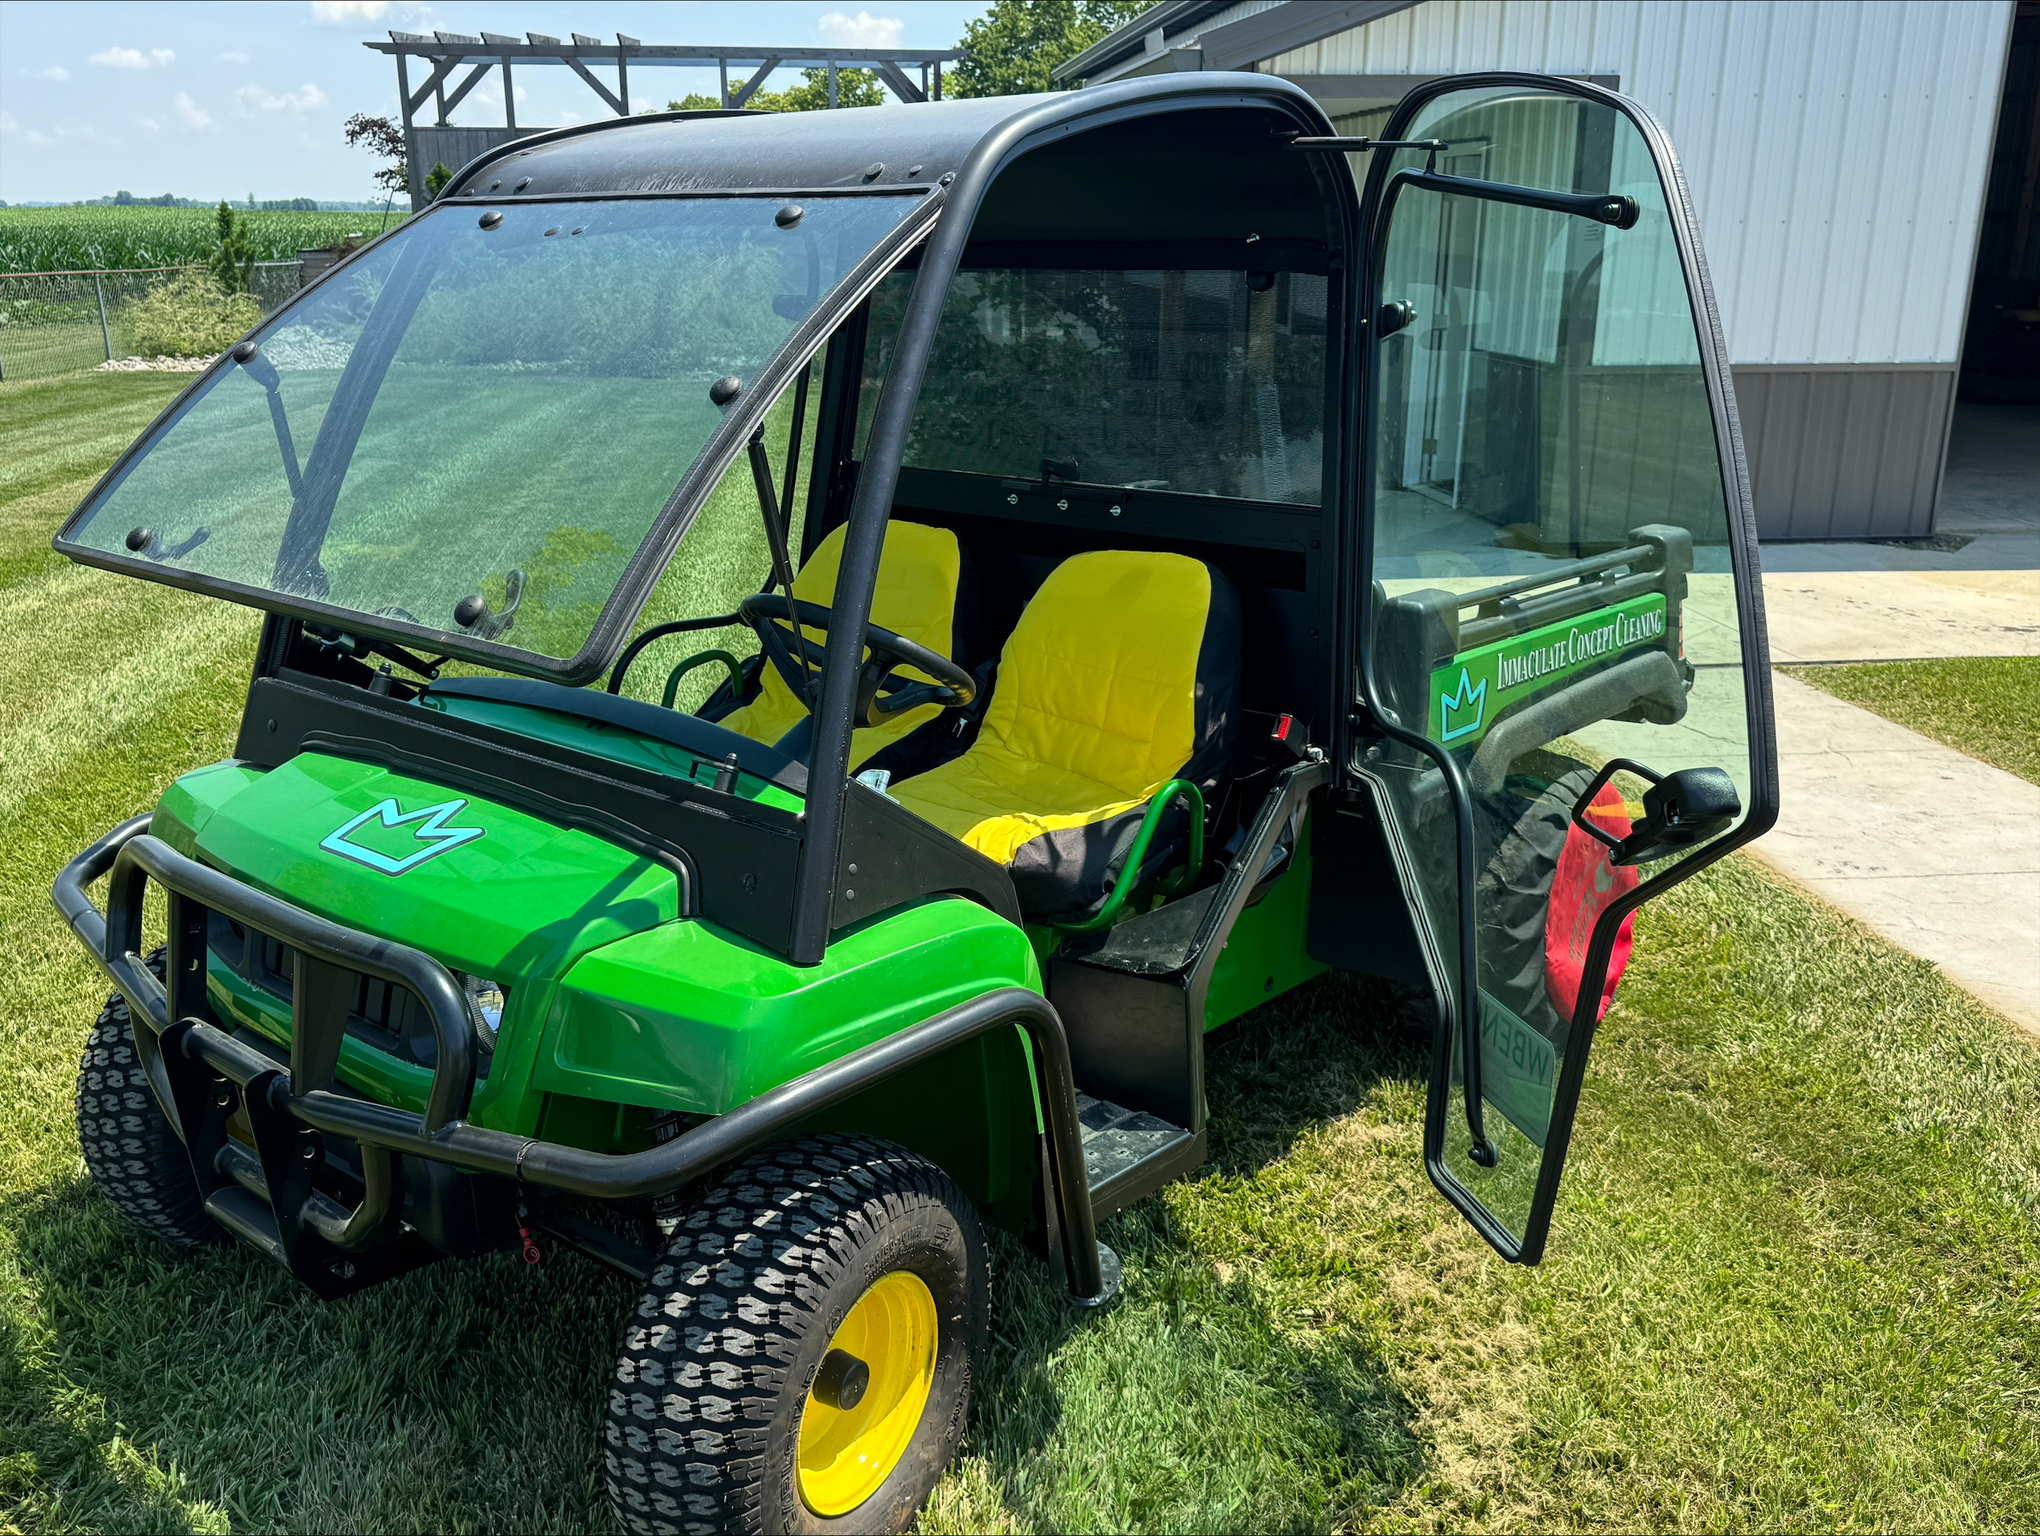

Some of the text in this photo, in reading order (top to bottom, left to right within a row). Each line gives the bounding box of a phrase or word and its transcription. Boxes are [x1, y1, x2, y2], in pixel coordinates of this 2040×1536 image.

[1497, 609, 1662, 690] IMMACULATE CONCEPT CLEANING
